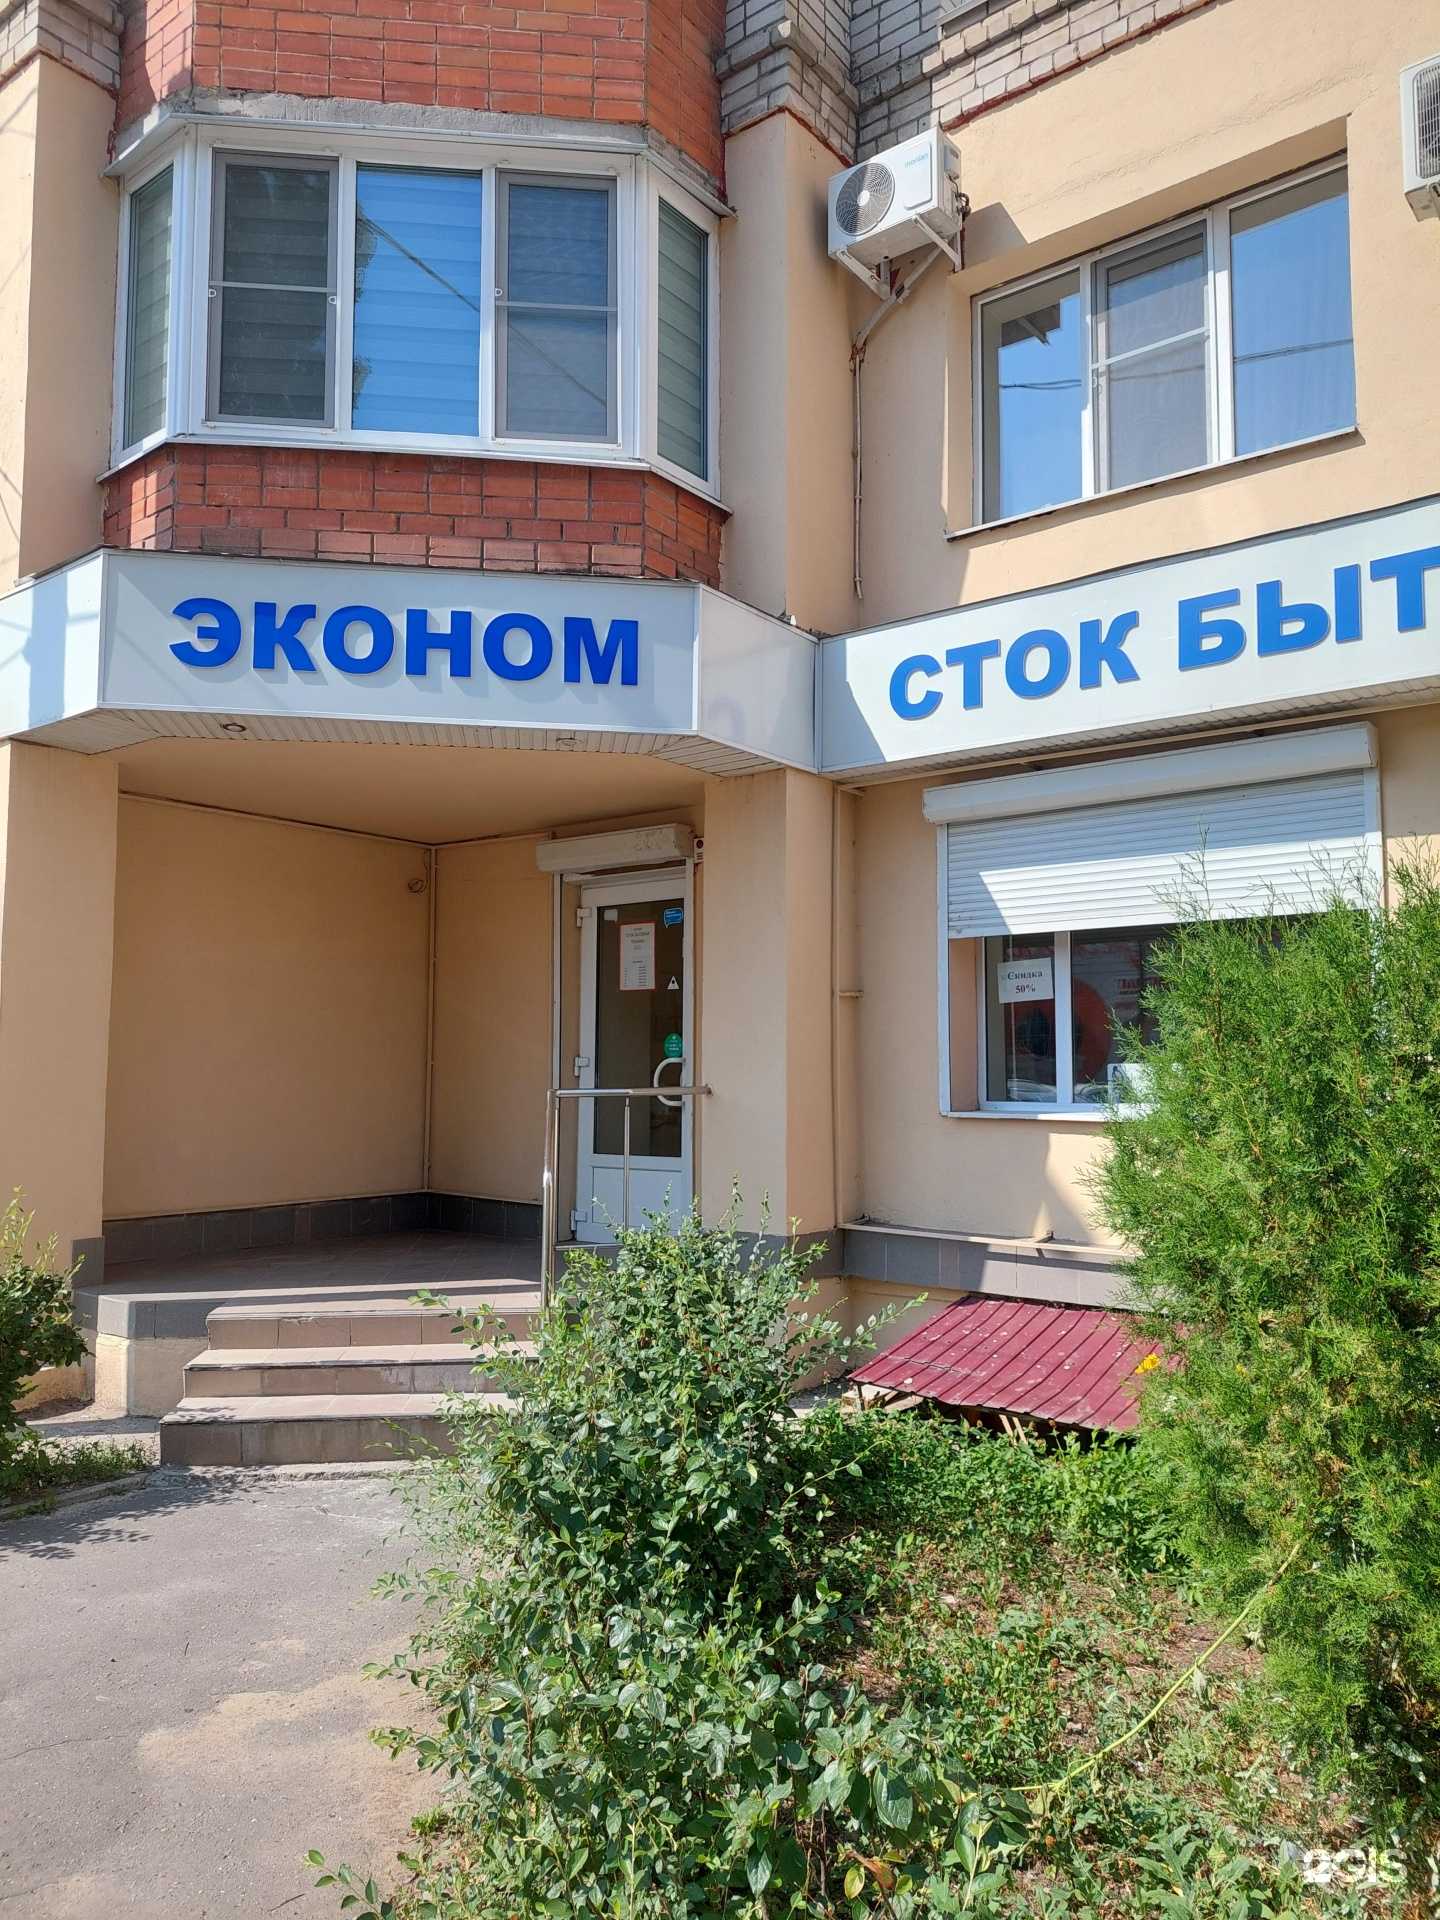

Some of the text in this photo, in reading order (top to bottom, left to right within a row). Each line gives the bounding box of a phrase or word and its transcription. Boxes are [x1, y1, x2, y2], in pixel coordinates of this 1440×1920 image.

[169, 597, 639, 687] ЭКОНОМ
[889, 545, 1440, 721] СТОК БЫТ
[1006, 970, 1043, 981] Скидка
[1015, 984, 1036, 994] 50%
